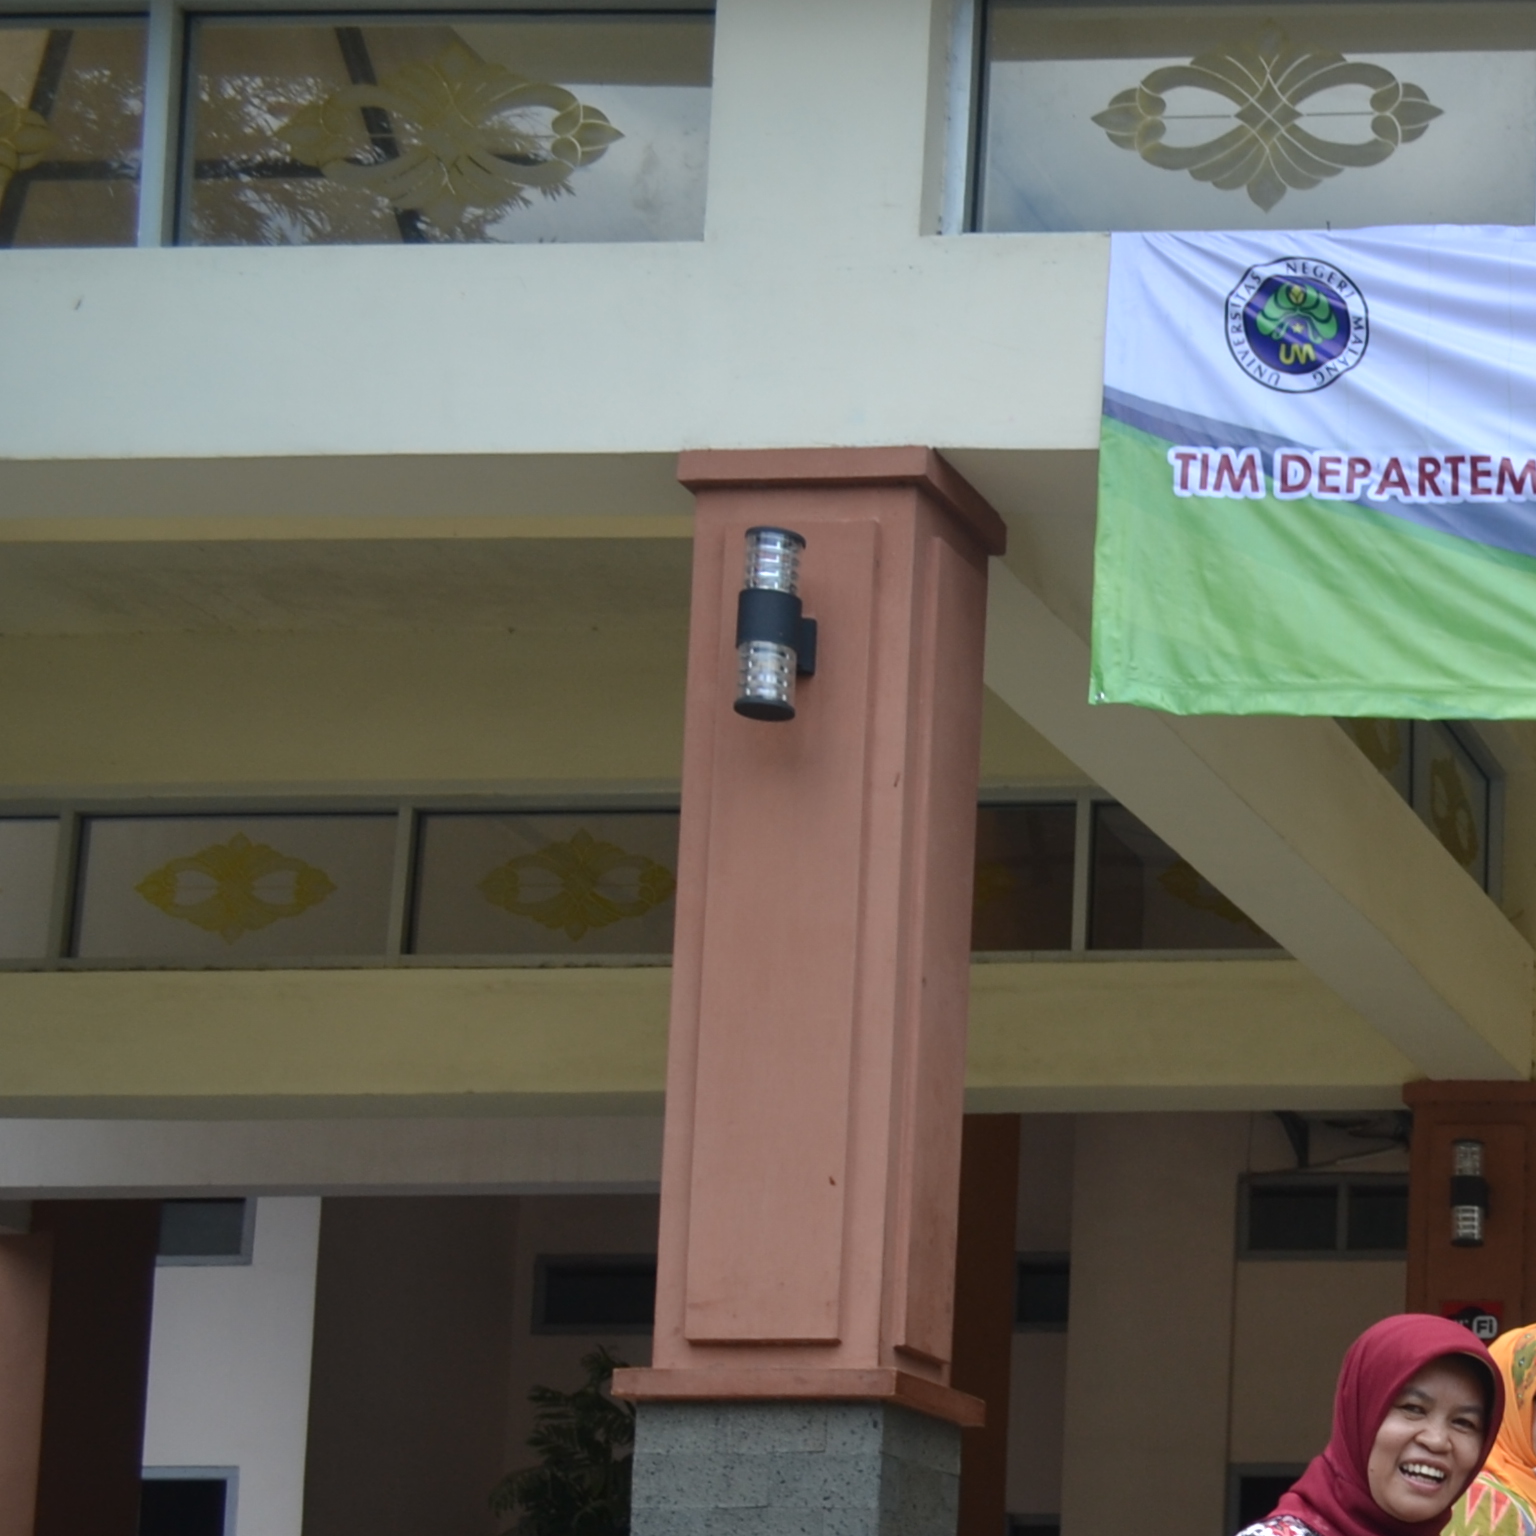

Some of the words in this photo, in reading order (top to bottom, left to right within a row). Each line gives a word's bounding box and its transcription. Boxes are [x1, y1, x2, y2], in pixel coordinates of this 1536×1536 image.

[1286, 261, 1356, 299] NEGERI
[1229, 271, 1281, 386] UNIVERSITAS
[1312, 315, 1364, 386] MALANG
[1174, 452, 1260, 494] TIM
